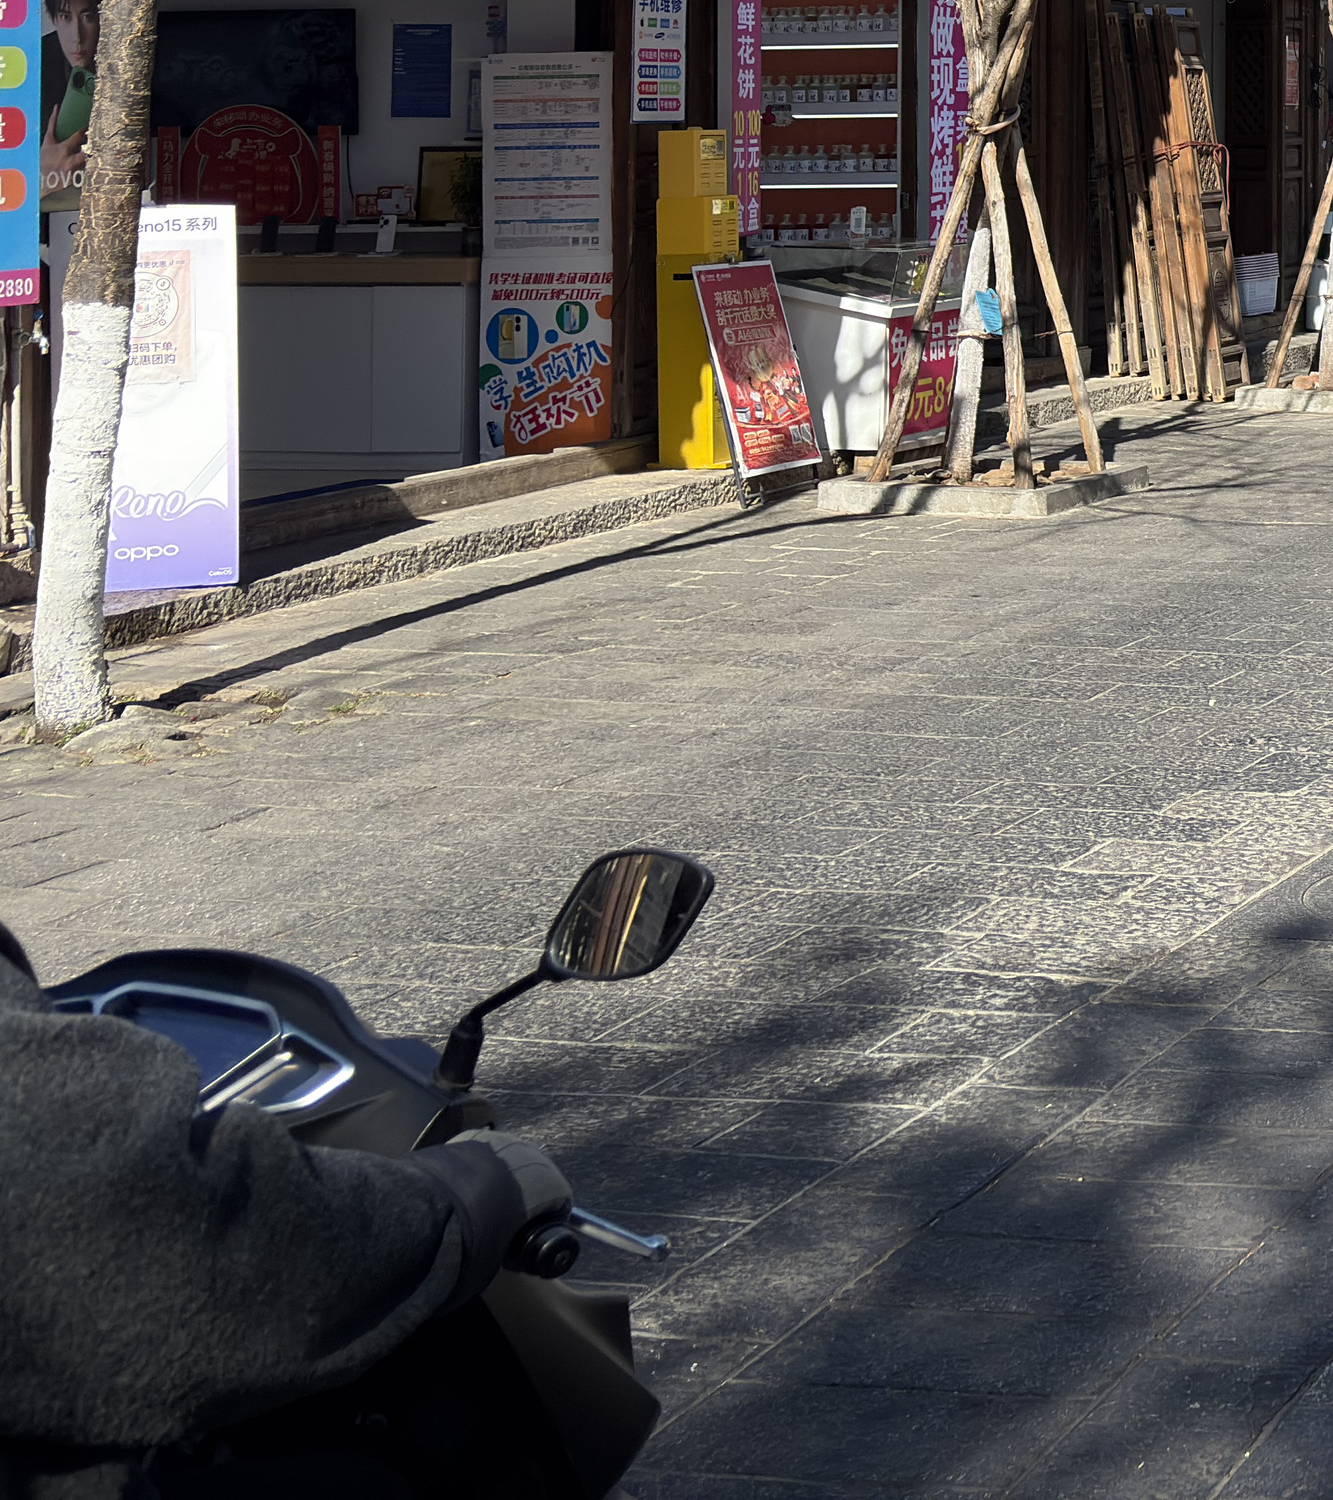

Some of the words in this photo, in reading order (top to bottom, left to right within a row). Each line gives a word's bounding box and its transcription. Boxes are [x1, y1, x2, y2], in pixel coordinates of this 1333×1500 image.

[138, 219, 182, 233] eno15
[185, 216, 218, 231] 系列
[714, 289, 743, 308] 来移动
[744, 287, 770, 304] 办业务
[716, 304, 777, 326] 刮千元话费大奖
[890, 319, 959, 368] 免品尝
[487, 340, 609, 410] 学生购机
[512, 380, 600, 441] 狂欢节
[112, 485, 198, 521] Reno
